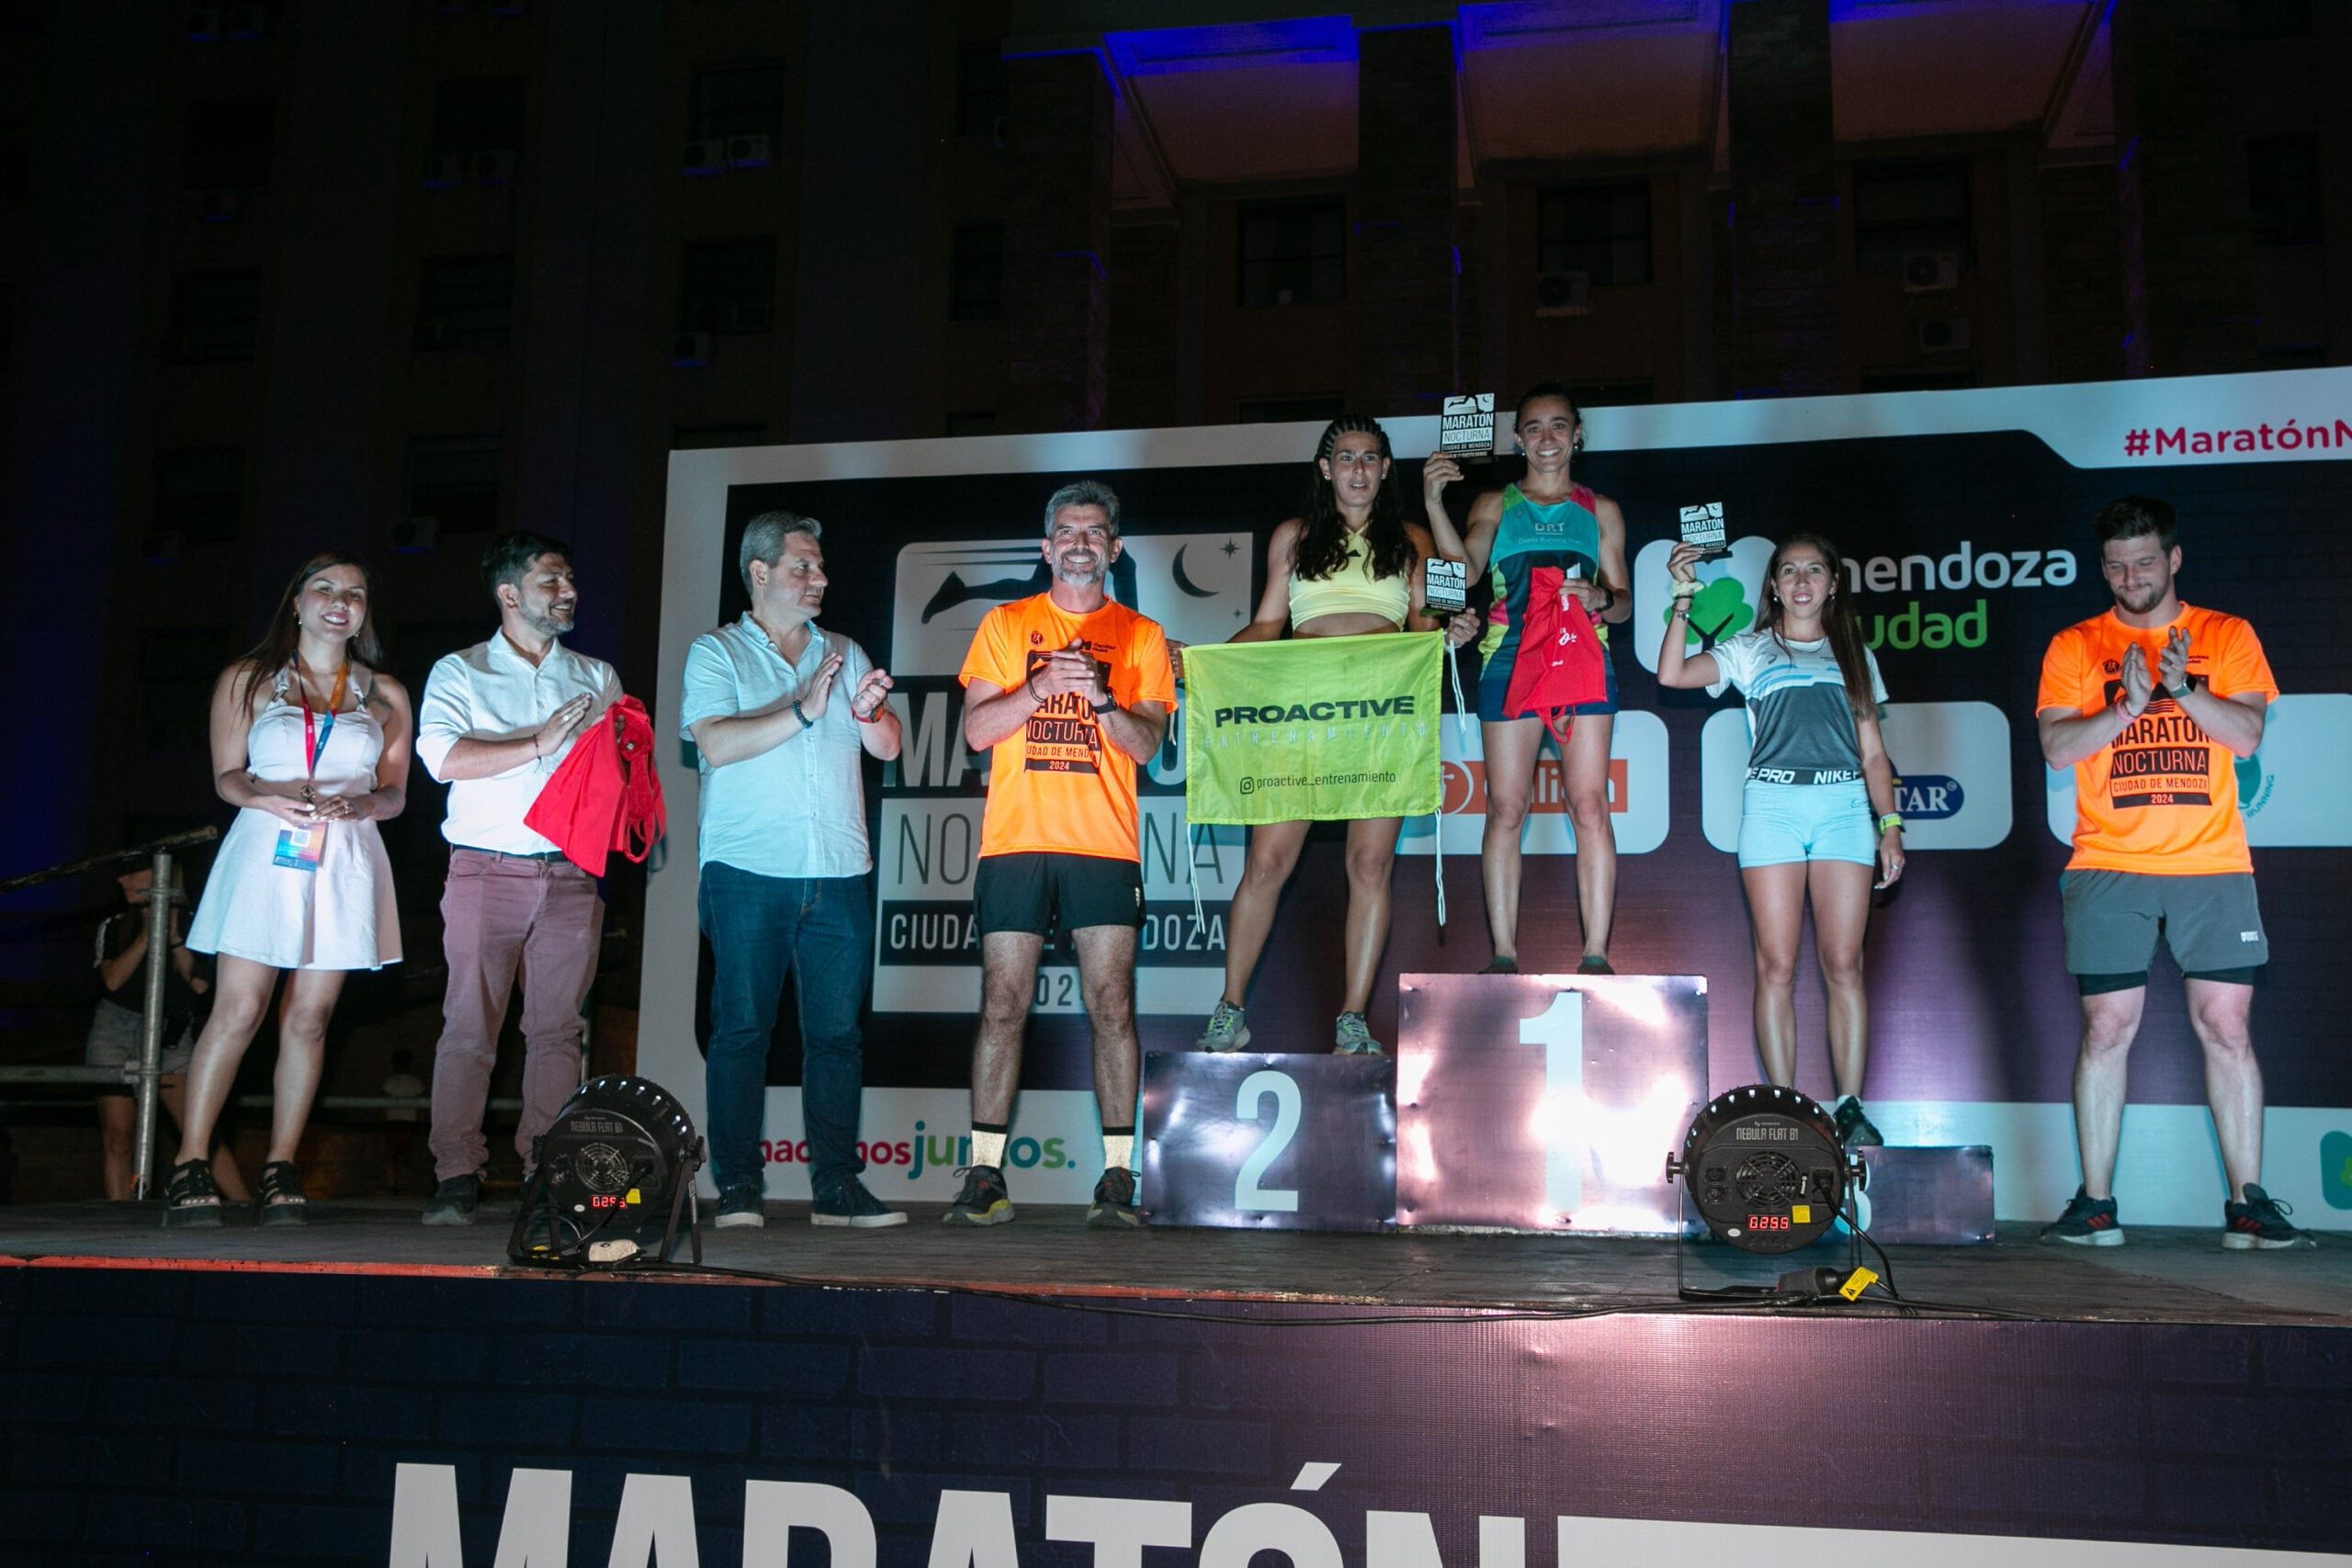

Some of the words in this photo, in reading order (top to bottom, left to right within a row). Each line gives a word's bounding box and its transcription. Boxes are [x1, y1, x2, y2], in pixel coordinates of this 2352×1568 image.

[1444, 429, 1490, 443] NOCTURNA
[1855, 599, 1987, 650] udad
[1215, 695, 1415, 728] PROACTIVE
[1052, 746, 1062, 757] DE
[1049, 761, 1069, 771] 2024
[2113, 750, 2206, 774] NOCTURNA
[1257, 770, 1396, 790] proactive_entrenamiento
[1757, 768, 1795, 784] PRO
[2113, 779, 2146, 793] CIUDAD
[2150, 778, 2162, 789] DE
[1894, 785, 1951, 812] TAR
[2151, 794, 2174, 804] 2024
[890, 914, 981, 950] CIUDA
[1519, 992, 1583, 1212] 1
[1235, 1070, 1302, 1212] 2
[1736, 1128, 1767, 1140] NEBULA
[1770, 1128, 1787, 1140] FLAT
